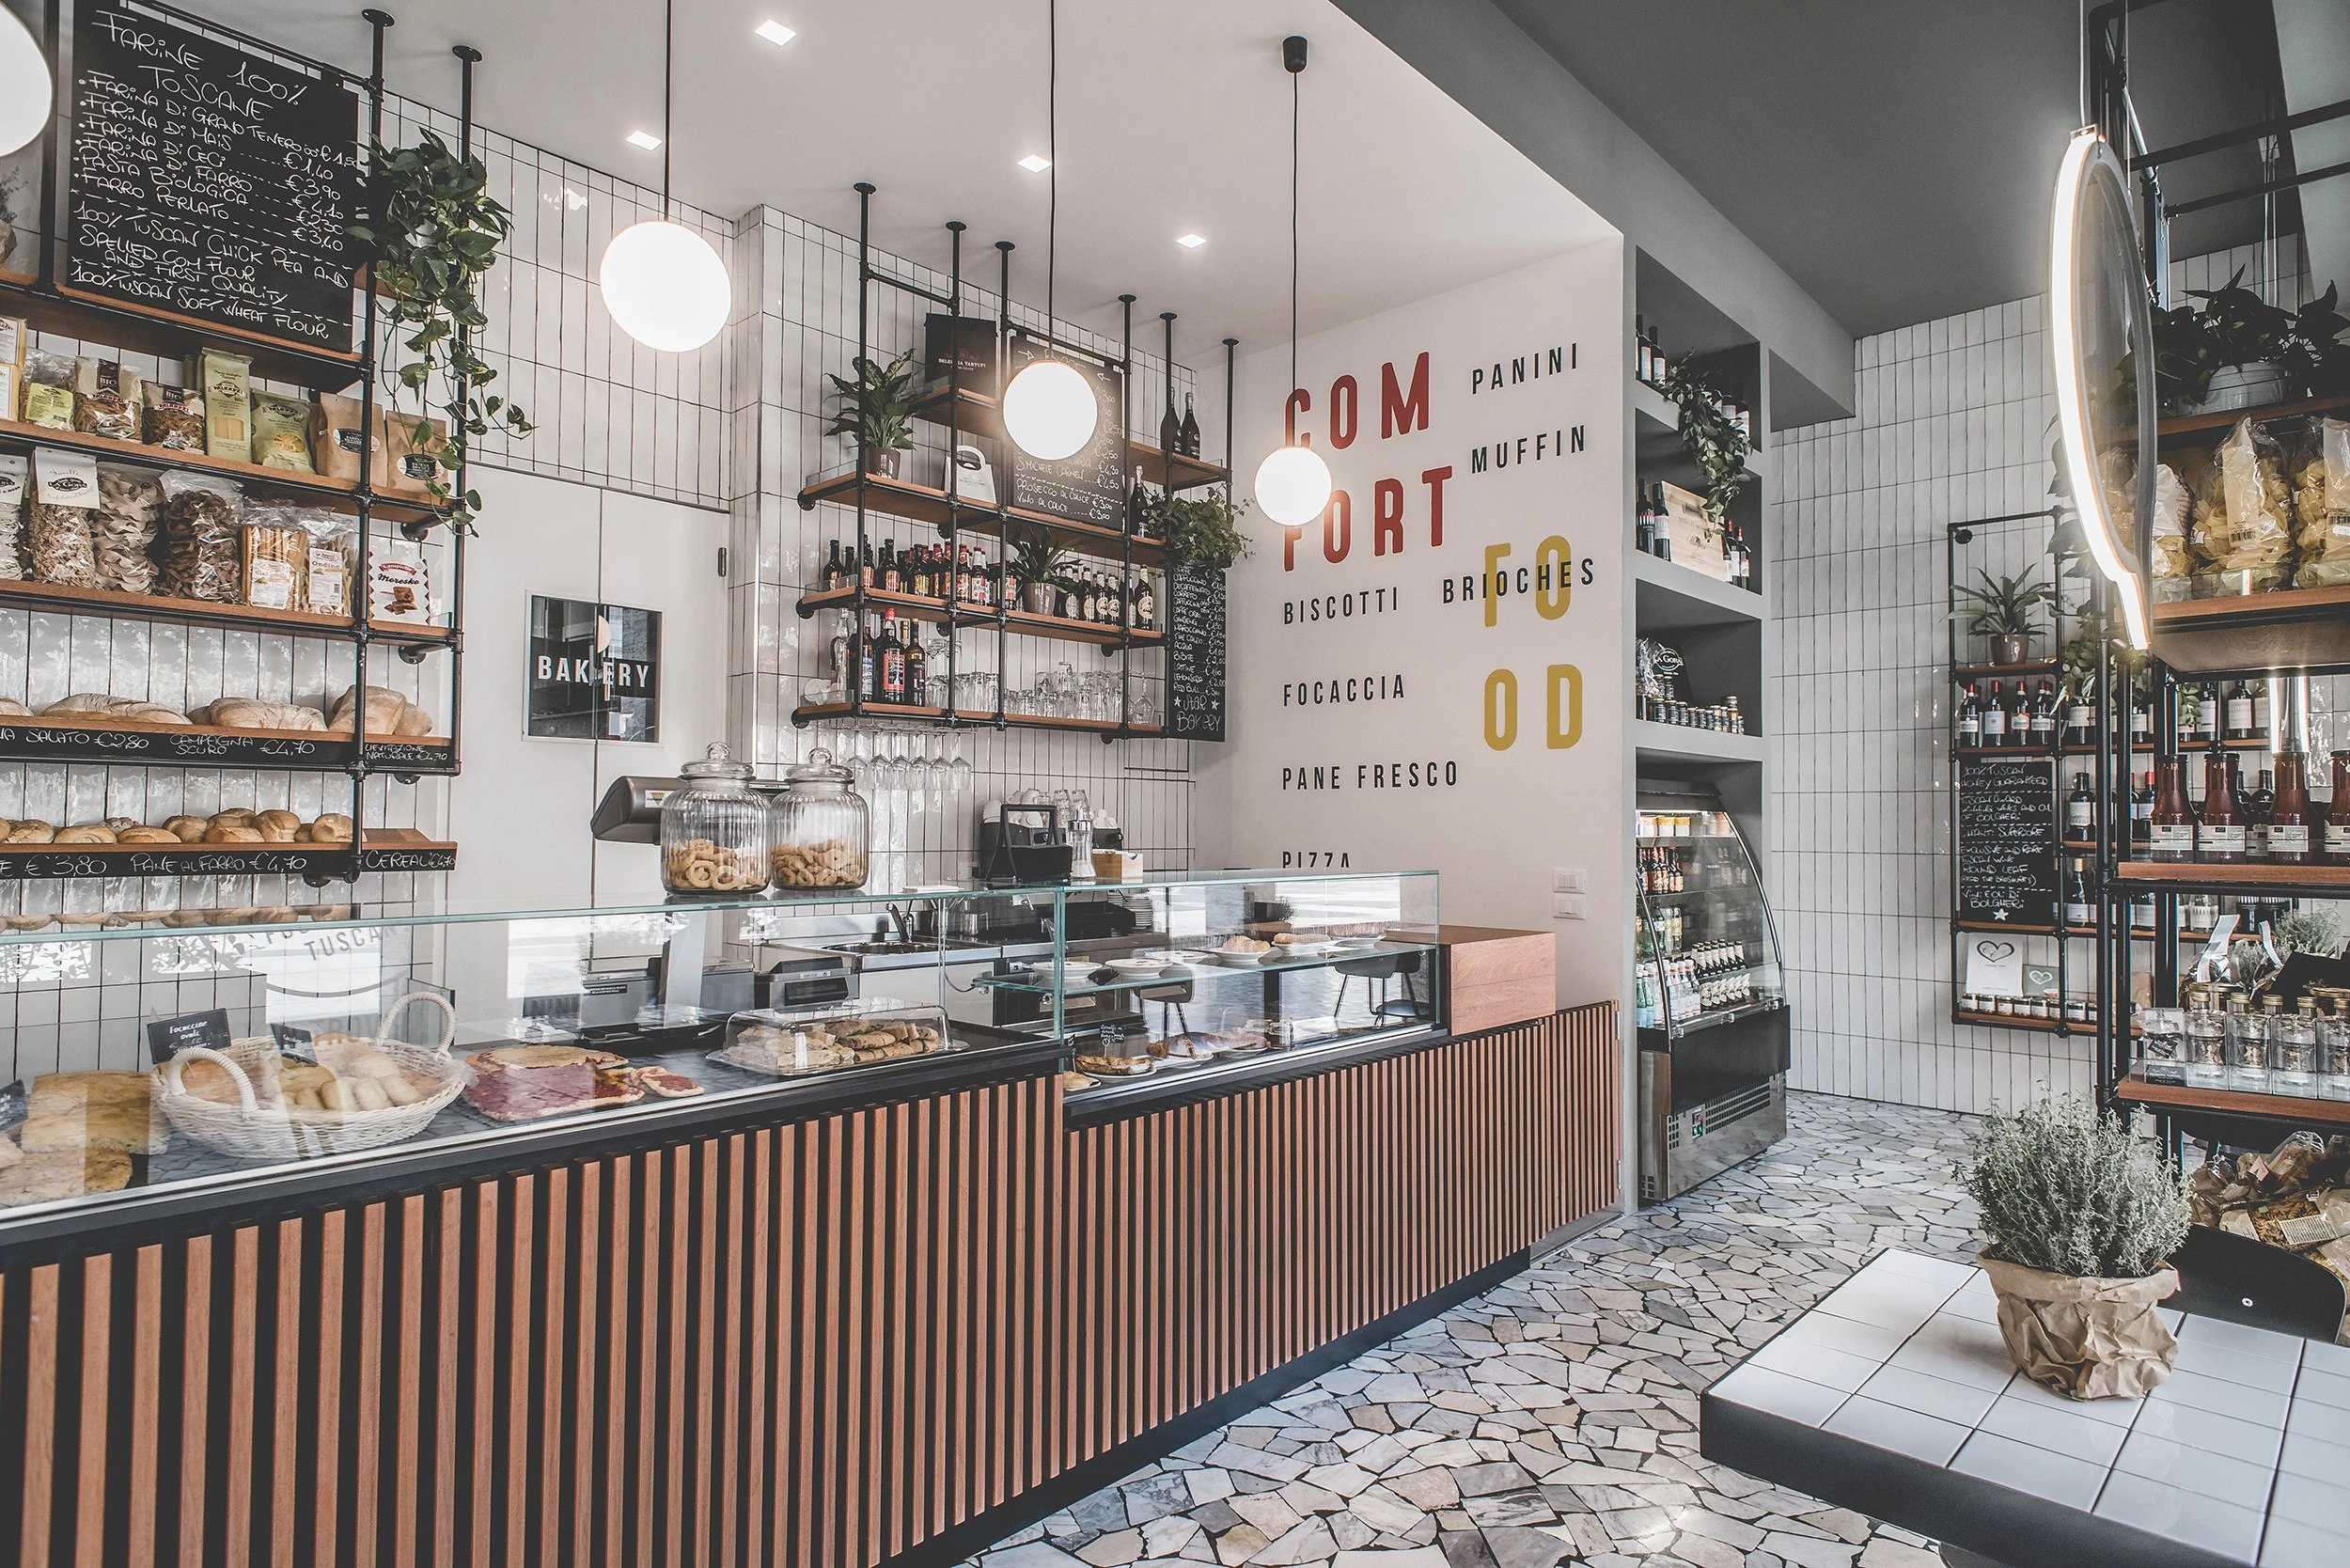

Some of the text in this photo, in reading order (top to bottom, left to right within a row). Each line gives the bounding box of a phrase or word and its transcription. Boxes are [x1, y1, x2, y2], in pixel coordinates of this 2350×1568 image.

[226, 61, 307, 105] 100%
[246, 125, 302, 151] TENERO
[79, 145, 140, 177] PASTA
[195, 165, 252, 192] FARRO
[81, 166, 344, 251] FARRO PERLATO €3,40
[73, 200, 122, 227] 100%
[125, 214, 200, 246] TUSCAN
[271, 248, 303, 274] PEA
[314, 266, 348, 288] AND
[79, 224, 158, 260] SPELLED
[205, 256, 255, 282] FLOUR
[104, 249, 145, 268] AND
[153, 260, 208, 282] FIRST
[70, 266, 329, 338] 100% TUSCAN SOFT WHEAT FLOUR
[100, 377, 117, 385] BIO
[1472, 342, 1577, 395] PANINI
[165, 391, 182, 400] BIO
[1284, 352, 1429, 449] COM
[1471, 424, 1586, 474] MUFFIN
[1443, 557, 1593, 604] BRIOCHES
[1284, 587, 1398, 625] BISCOTTI
[538, 655, 649, 687] BAKERY
[1283, 674, 1404, 707] FOCACCIA
[1483, 664, 1583, 751] OD
[25, 729, 90, 744] SALATO
[94, 732, 149, 749] €2,80
[170, 733, 315, 756] CAMPAGNA €4,70
[176, 745, 227, 755] SCURO
[366, 751, 415, 760] NATURALE
[1282, 760, 1457, 791] PANE FRESCO
[131, 853, 179, 873] PANE
[198, 854, 245, 871] FARRO
[248, 852, 307, 873] €4,70
[2001, 864, 2029, 874] LEAF
